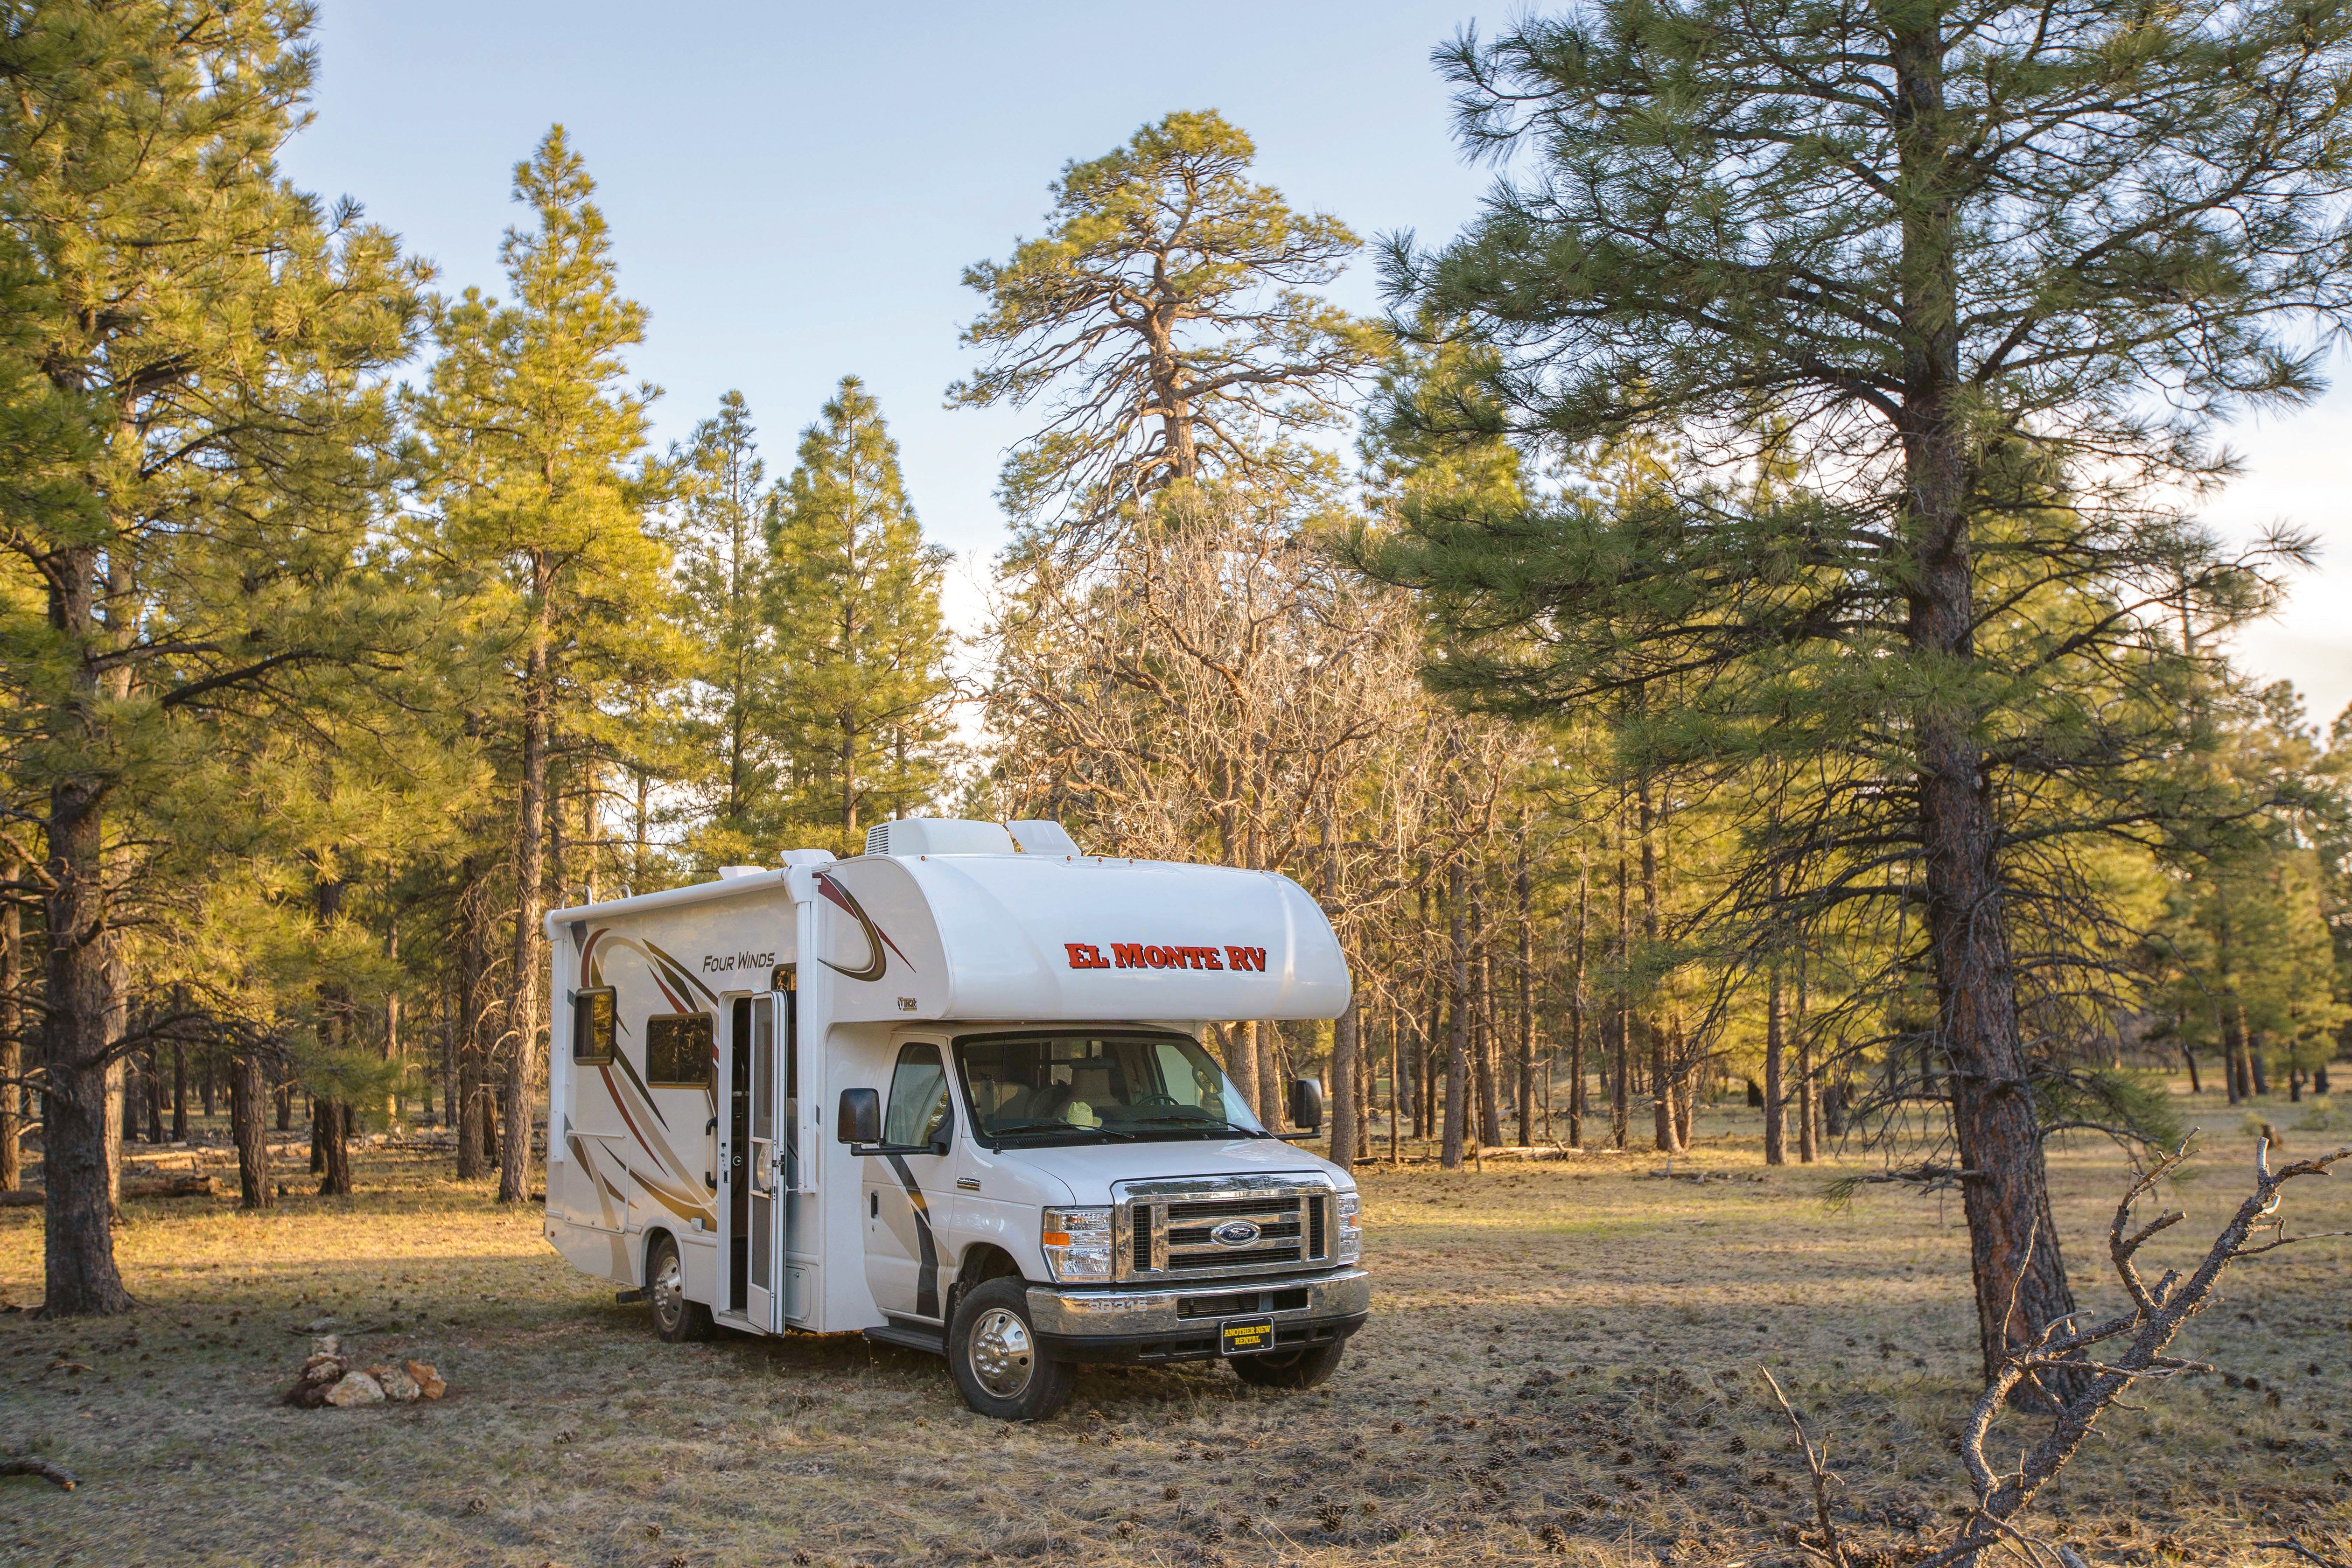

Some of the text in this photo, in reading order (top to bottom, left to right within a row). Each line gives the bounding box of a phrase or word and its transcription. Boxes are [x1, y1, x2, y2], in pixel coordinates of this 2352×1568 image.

[703, 951, 775, 973] FOUR WINDS
[1064, 943, 1267, 972] EL MONTE RV
[1229, 1228, 1251, 1238] Ford
[1088, 1300, 1148, 1314] 30315
[1224, 1325, 1271, 1337] ANOTHER NEW
[1235, 1336, 1260, 1344] RENTAL
